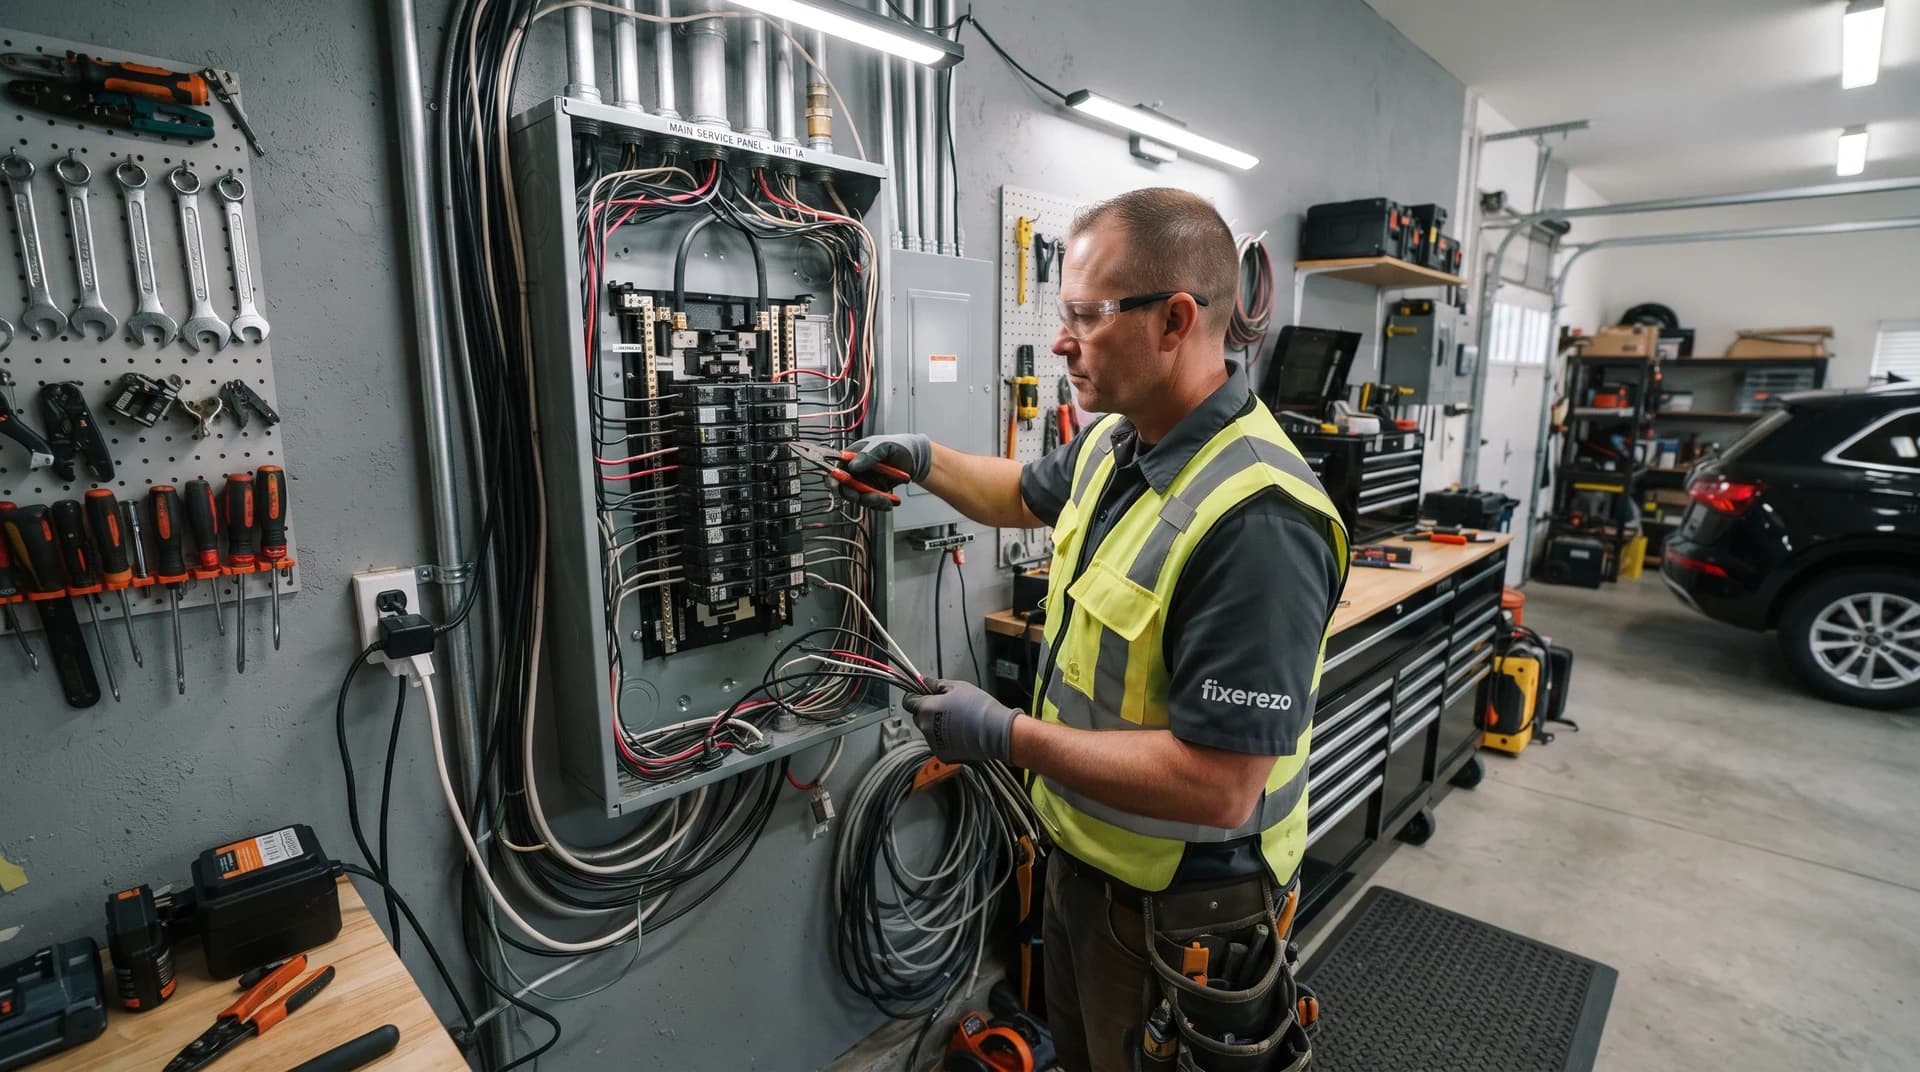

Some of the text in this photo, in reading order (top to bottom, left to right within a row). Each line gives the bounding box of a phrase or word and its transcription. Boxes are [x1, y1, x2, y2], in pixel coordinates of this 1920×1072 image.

[669, 123, 693, 136] MAIN
[697, 128, 734, 144] SERVICE
[737, 137, 764, 151] PANEL
[773, 144, 792, 157] UNIT
[794, 148, 804, 158] 1A
[1201, 679, 1292, 710] fixerezo
